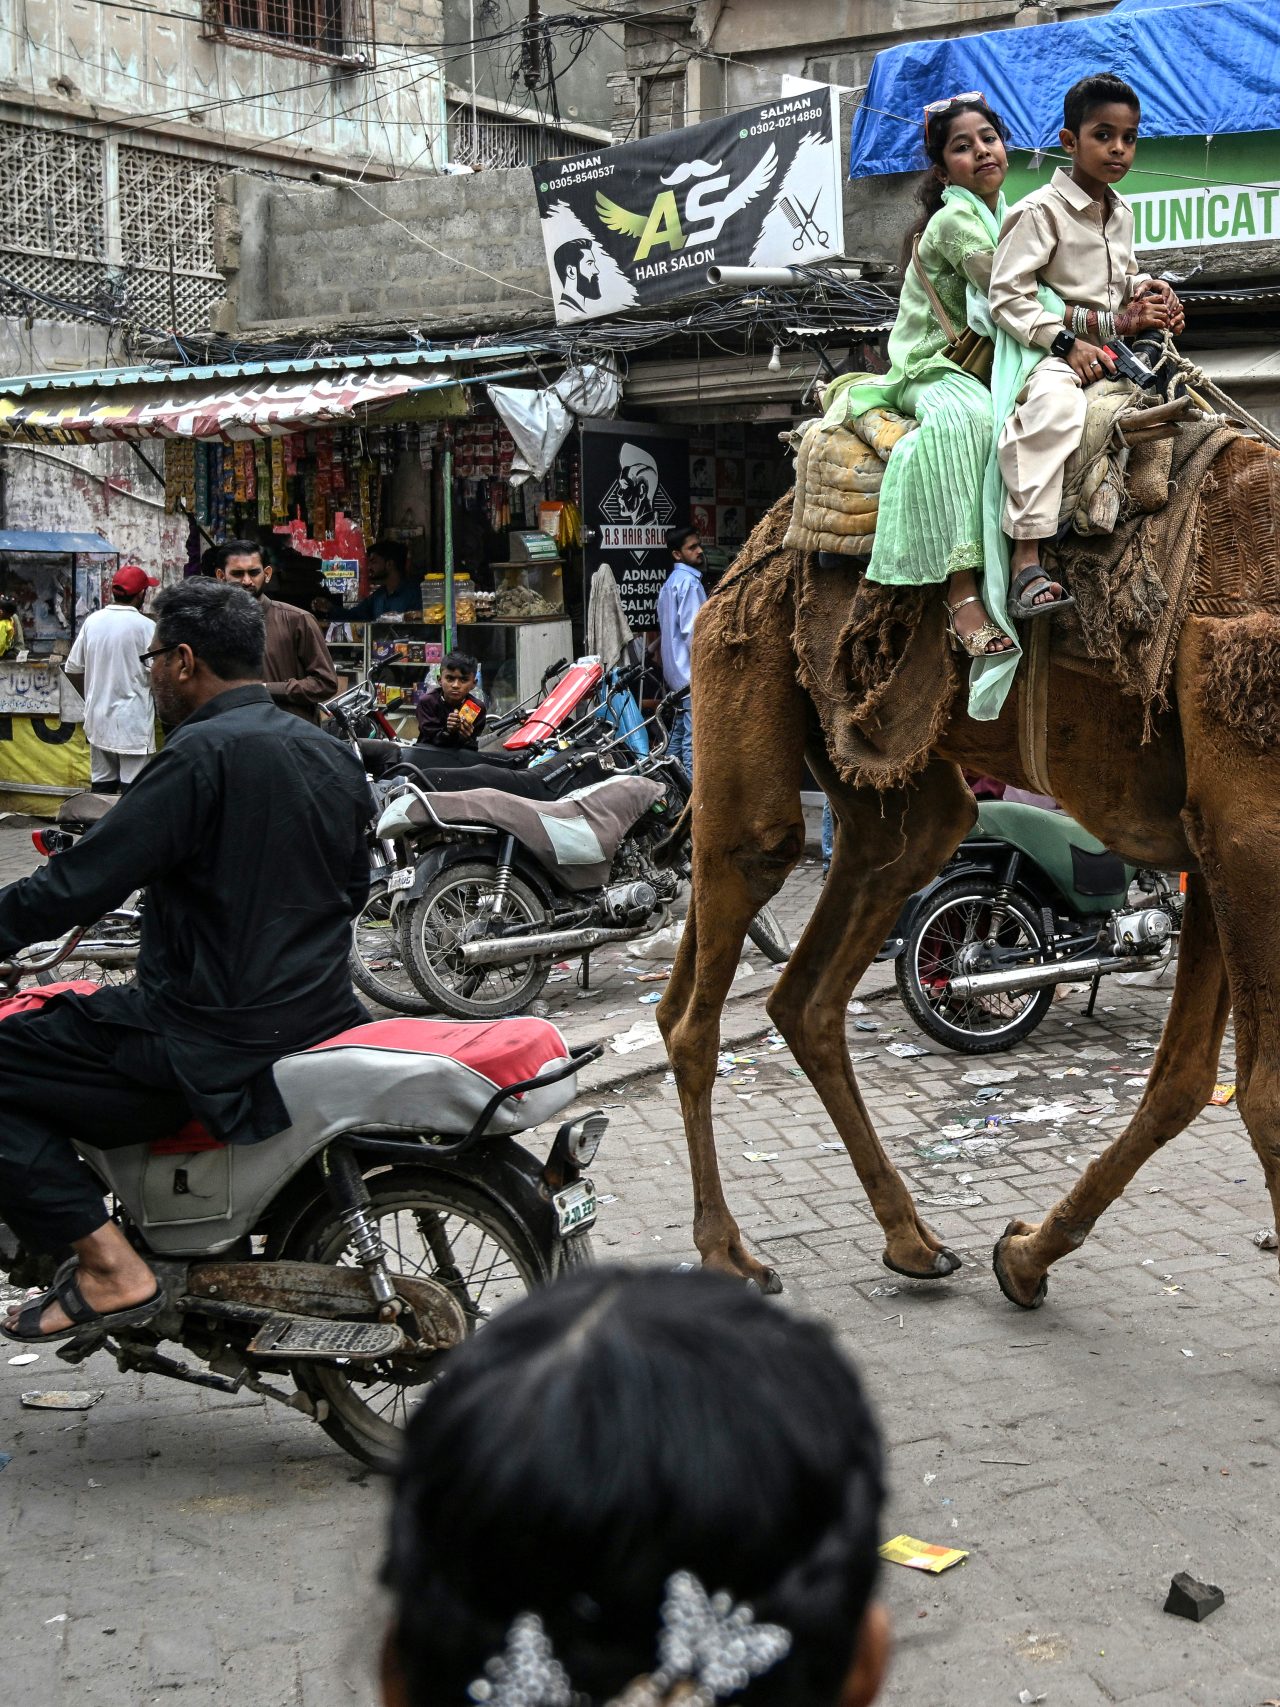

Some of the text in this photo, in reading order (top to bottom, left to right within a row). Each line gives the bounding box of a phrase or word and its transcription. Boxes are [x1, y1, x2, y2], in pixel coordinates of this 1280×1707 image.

[760, 97, 811, 120] SALMAN
[750, 107, 823, 136] 0302-0214880
[560, 155, 602, 175] ADNAN
[549, 164, 615, 190] 0305-8540537
[633, 174, 731, 262] AS
[635, 248, 716, 281] HAIR SALON
[604, 527, 669, 546] A.S HAIR SALO
[622, 569, 667, 581] ADNAN
[615, 582, 662, 596] 305-8540
[625, 613, 659, 626] 2-021
